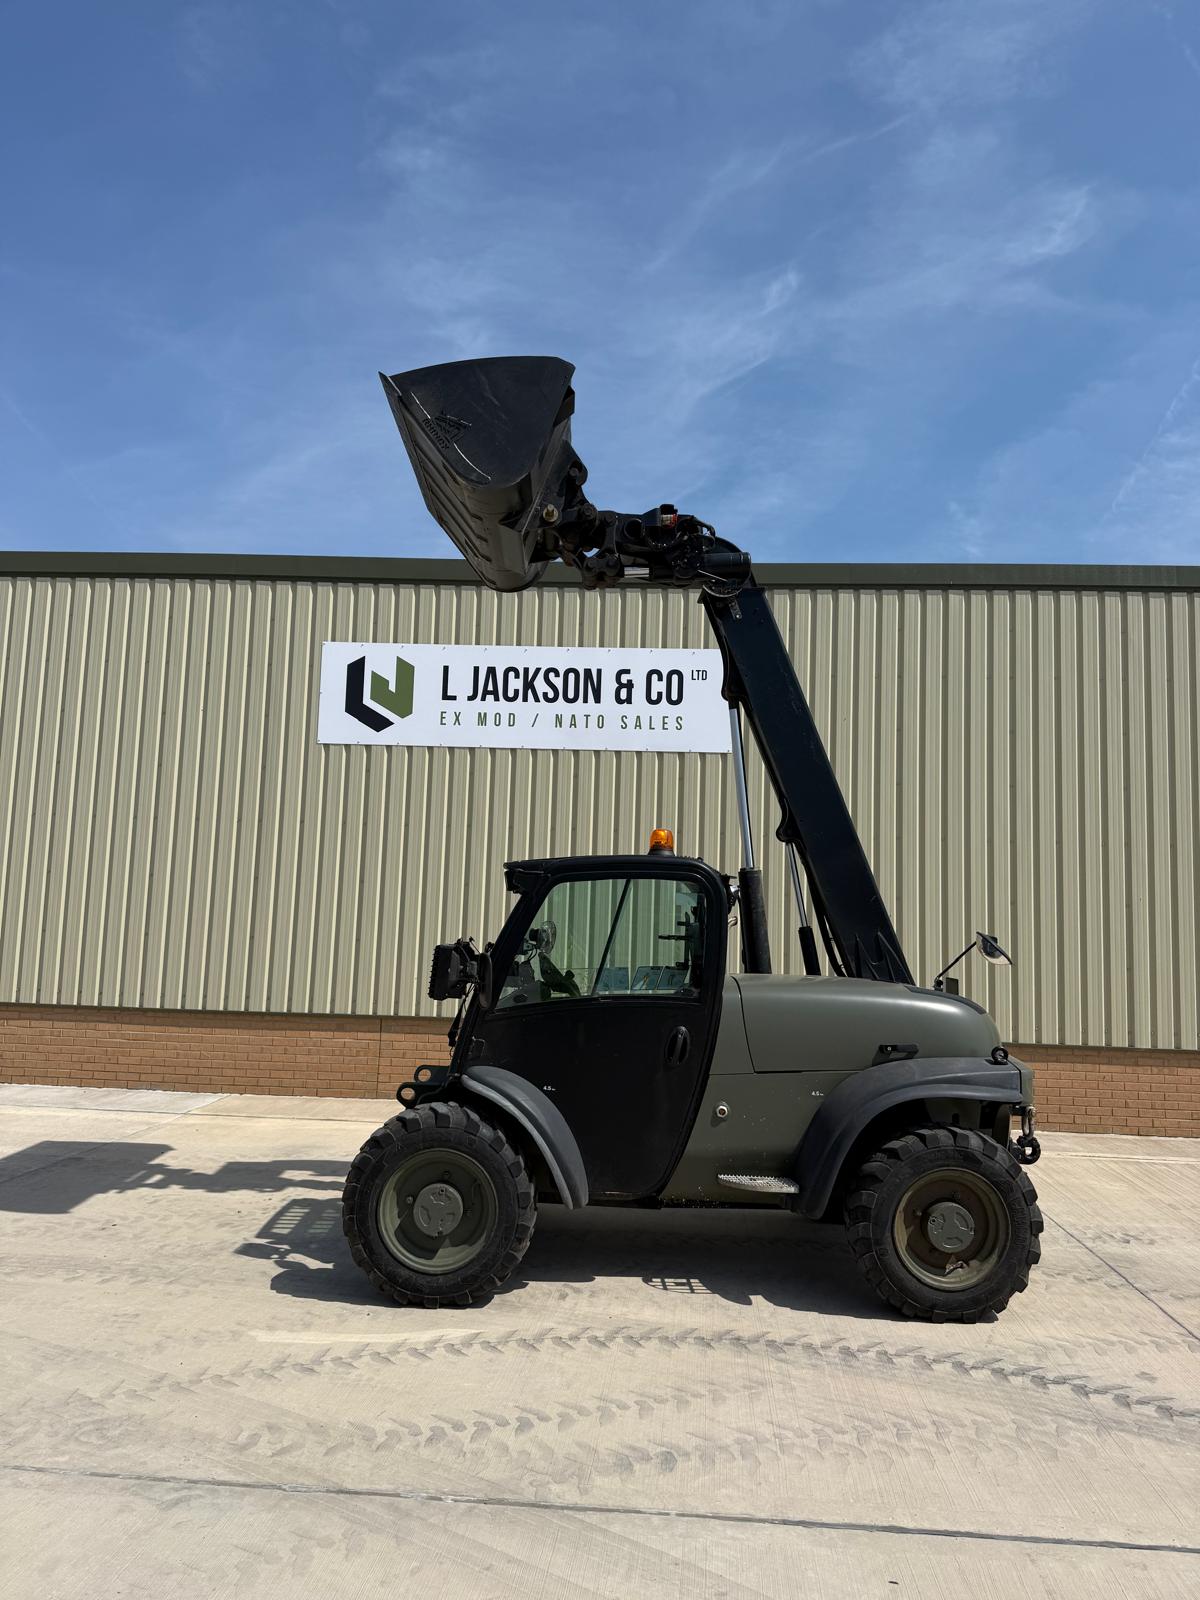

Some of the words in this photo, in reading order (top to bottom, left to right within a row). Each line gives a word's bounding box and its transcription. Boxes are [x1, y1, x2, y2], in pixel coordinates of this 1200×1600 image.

[441, 665, 458, 701] L
[466, 665, 603, 704] JACKSON
[614, 668, 635, 705] &
[645, 668, 684, 706] CO
[691, 669, 708, 681] LTD
[440, 711, 462, 726] EX
[477, 712, 516, 727] MOD
[531, 713, 539, 728] /
[555, 713, 605, 729] NATO
[620, 715, 683, 731] SALES
